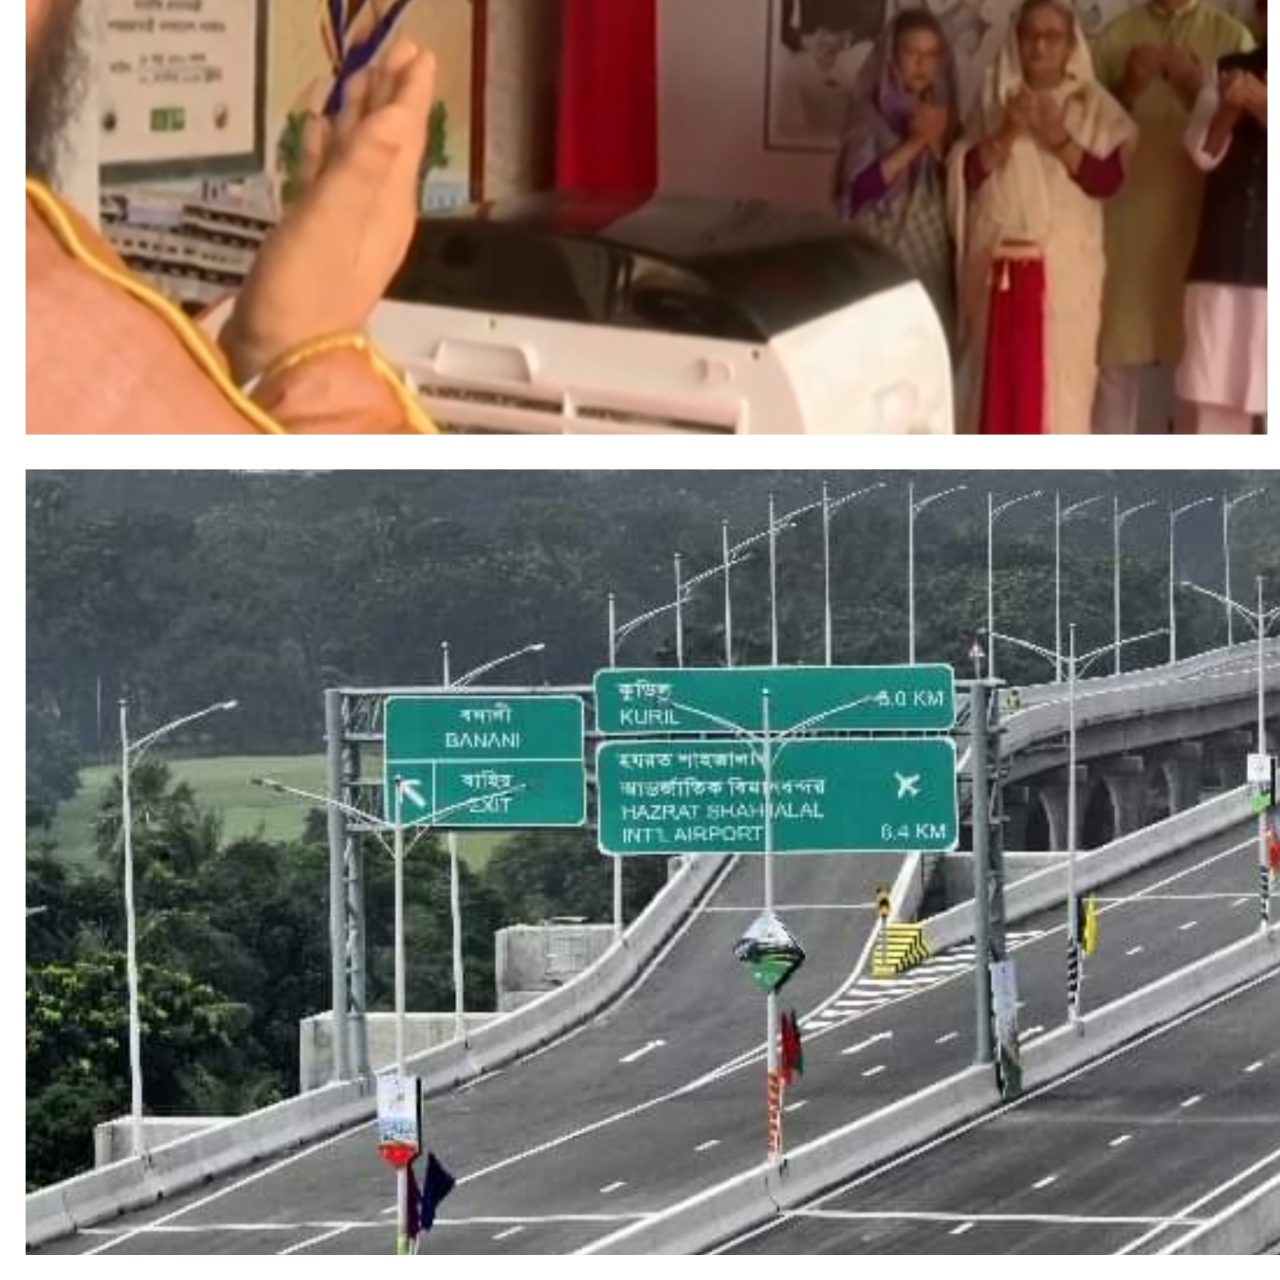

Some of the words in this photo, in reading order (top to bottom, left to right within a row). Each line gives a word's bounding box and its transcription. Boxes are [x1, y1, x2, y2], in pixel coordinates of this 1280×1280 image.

[914, 690, 944, 707] KM
[460, 702, 512, 724] বনানী
[620, 709, 682, 726] KURIL
[445, 732, 520, 749] BANANI
[619, 753, 673, 770] হযরত
[677, 751, 769, 770] শাহজালা
[460, 769, 513, 789] বাহির
[727, 776, 825, 798] বিমনবন্দর
[468, 796, 512, 814] EXIT
[621, 804, 700, 821] HAZRAT
[622, 827, 671, 844] INT'L
[674, 825, 764, 842] AIRPORT
[881, 823, 909, 841] 6.4
[915, 823, 946, 840] KM
